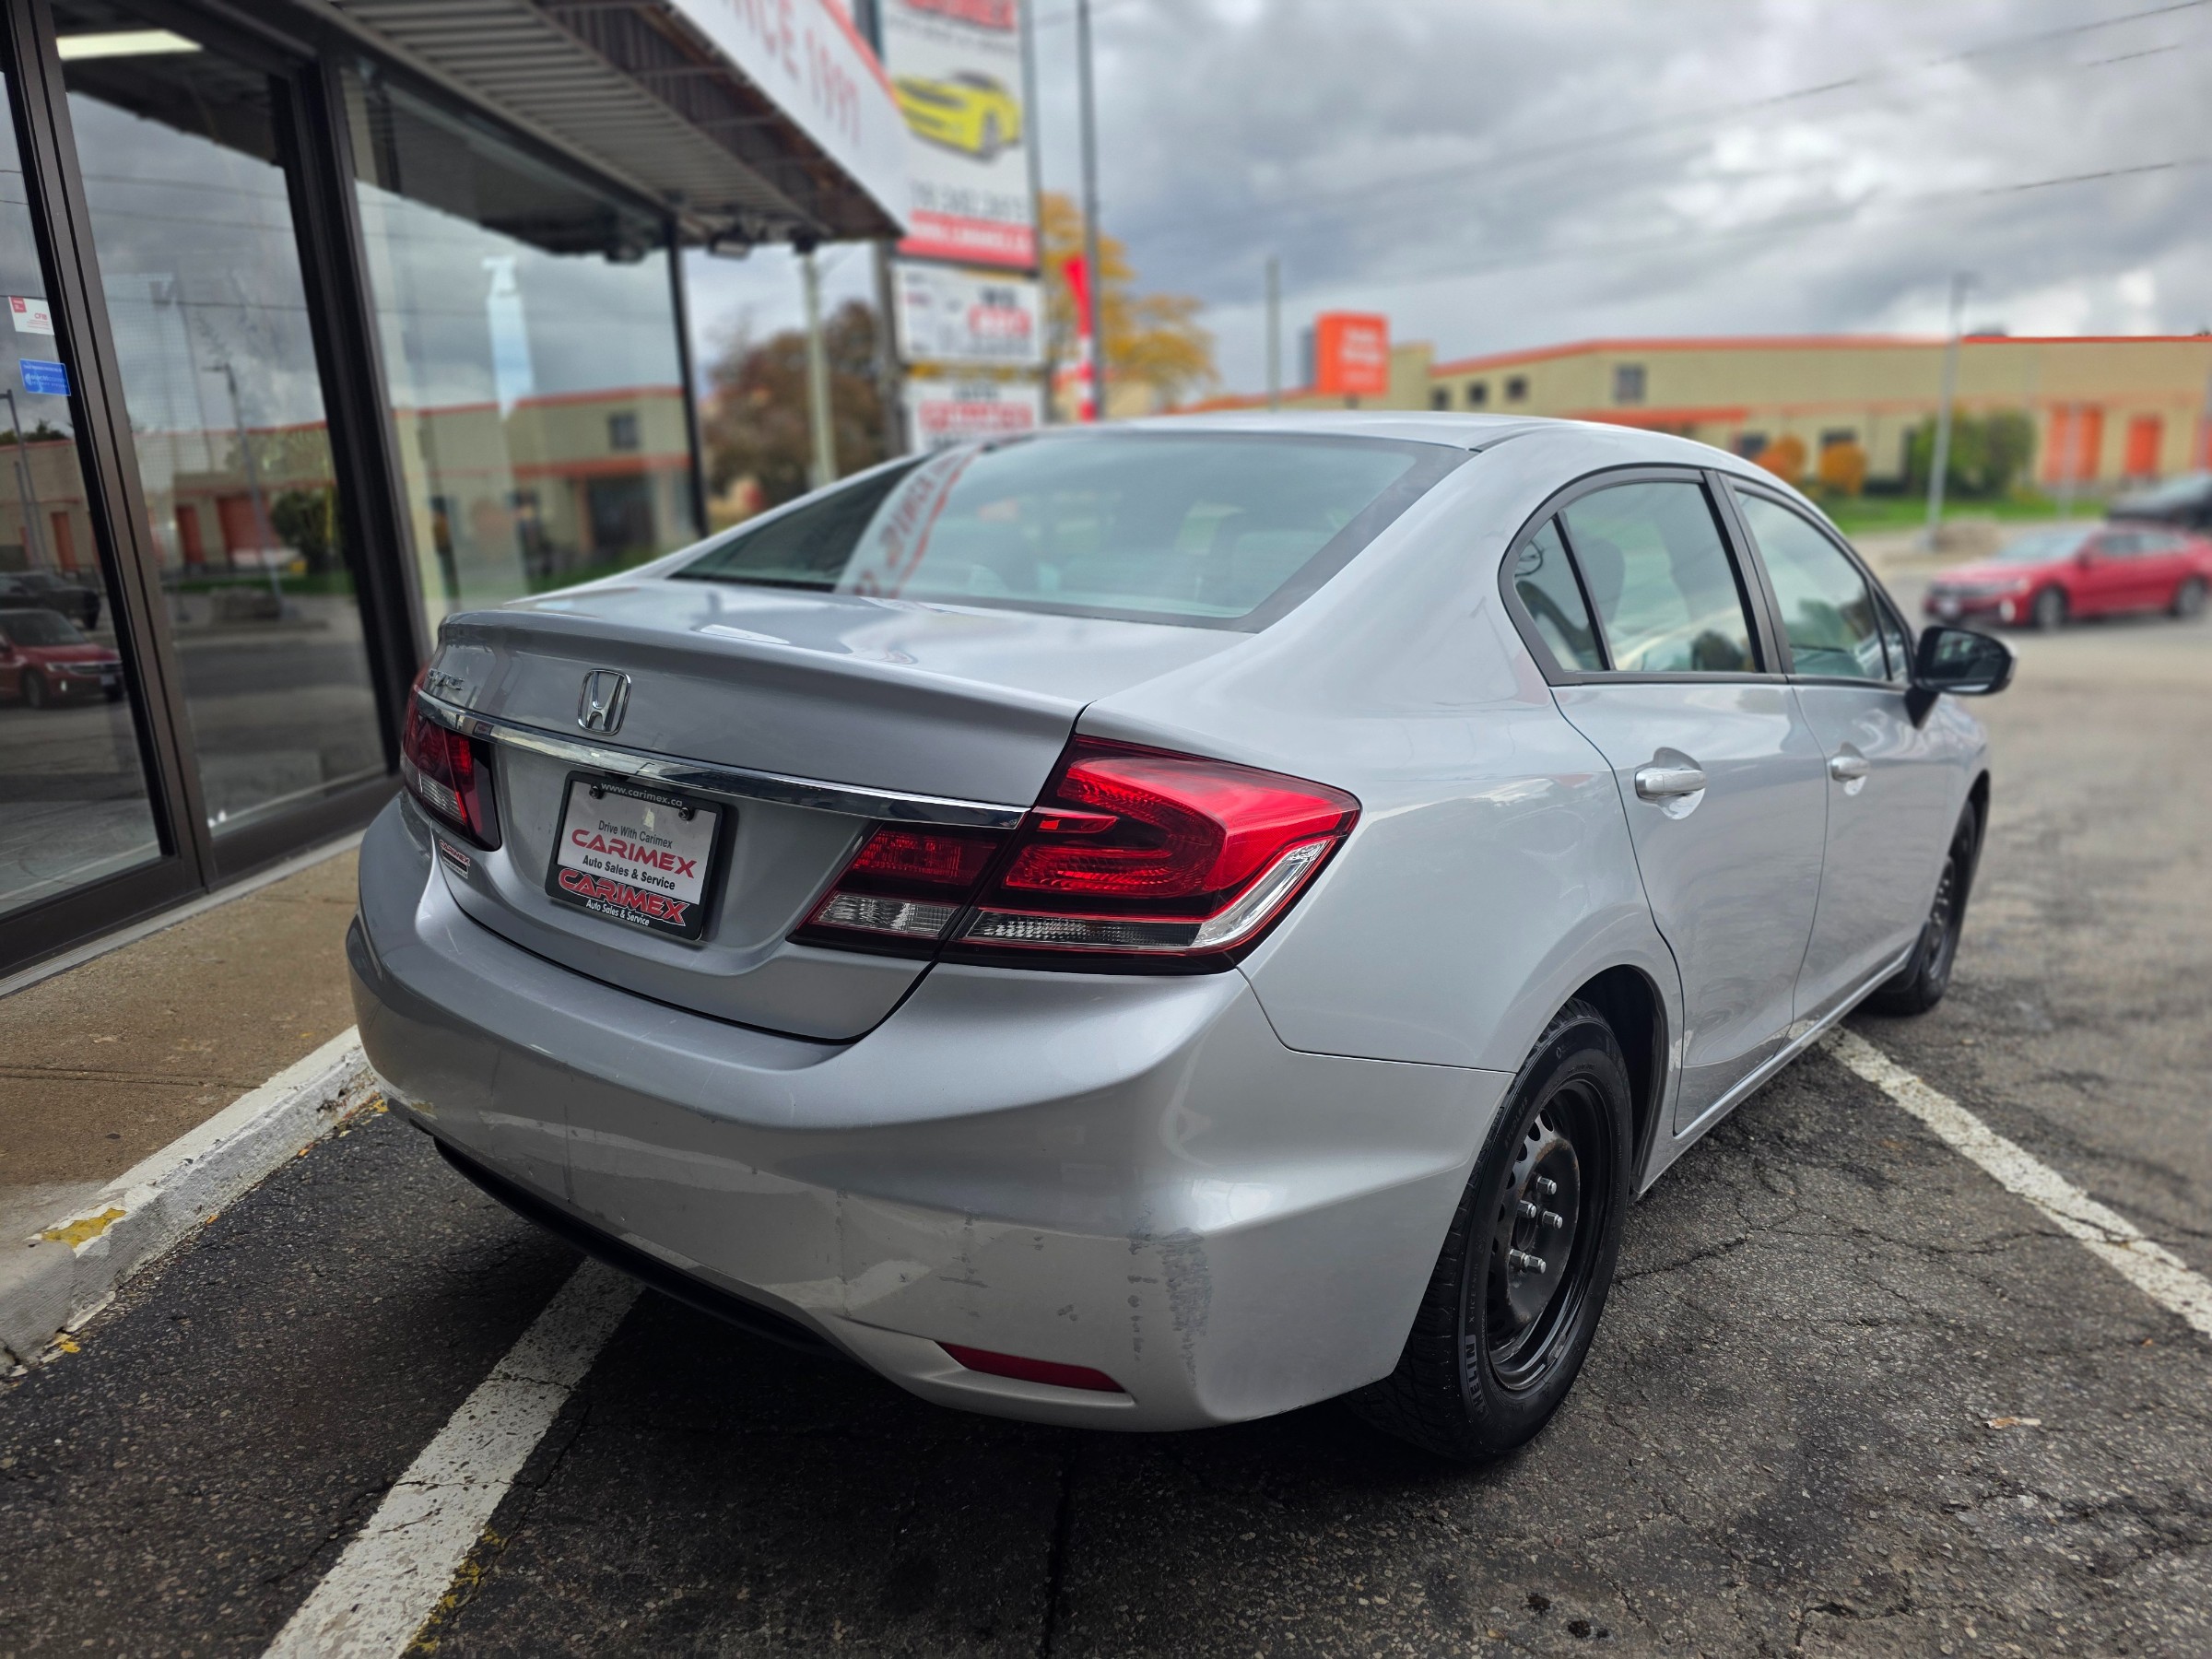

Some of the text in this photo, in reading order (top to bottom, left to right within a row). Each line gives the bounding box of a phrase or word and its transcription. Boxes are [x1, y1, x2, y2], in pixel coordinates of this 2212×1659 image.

[601, 782, 683, 807] www.carimex.ca
[598, 819, 673, 849] Drive With Carimex
[571, 829, 698, 878] CARIMEX
[582, 854, 676, 890] Auto Sales & Service
[559, 867, 689, 926] CARIMEX
[586, 899, 650, 926] Auto Sales & Service
